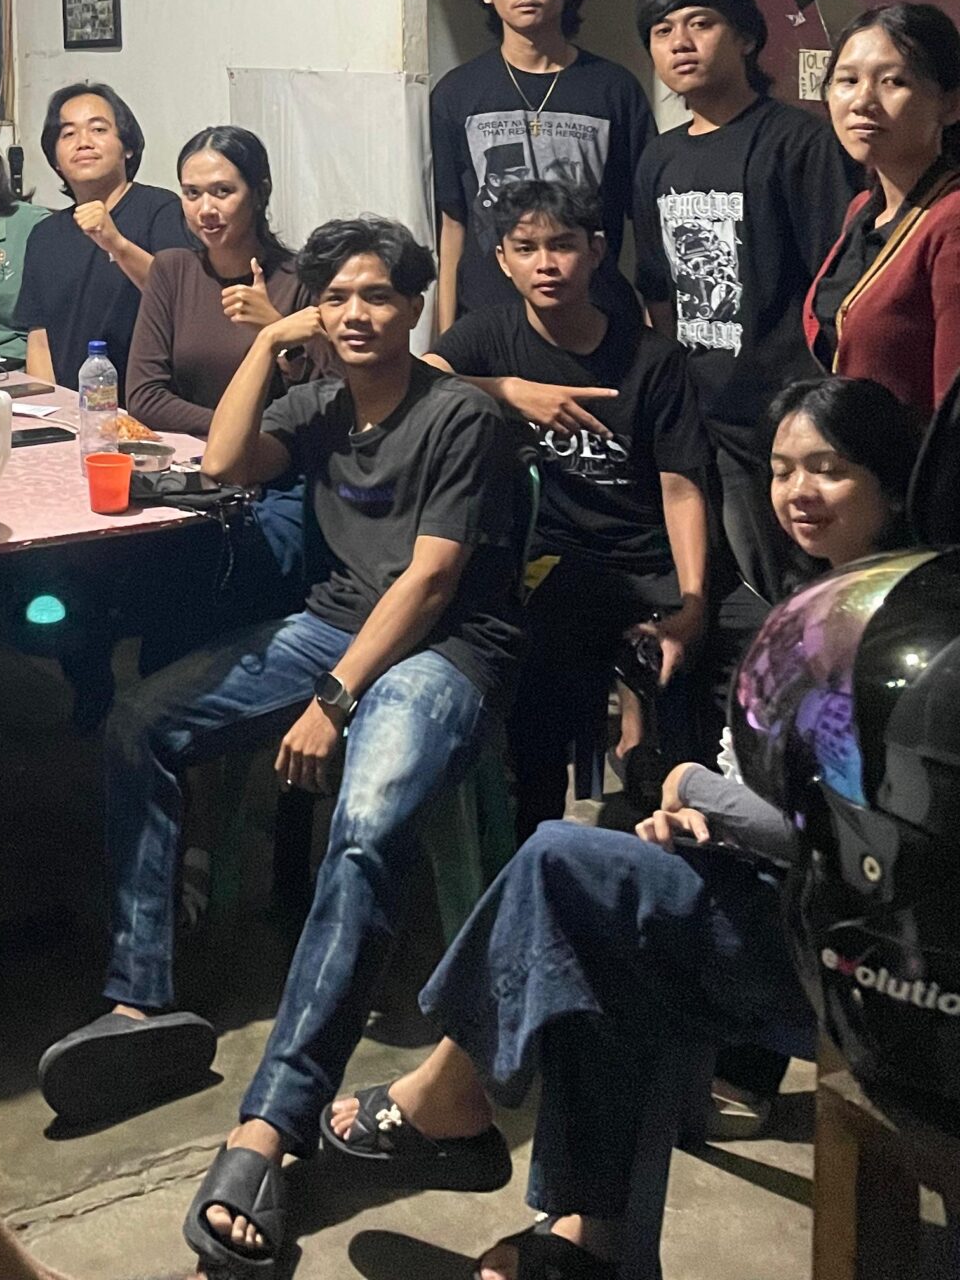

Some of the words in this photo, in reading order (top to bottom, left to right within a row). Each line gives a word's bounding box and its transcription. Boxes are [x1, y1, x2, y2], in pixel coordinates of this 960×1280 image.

[477, 120, 508, 131] GREAT
[555, 121, 563, 129] A
[564, 122, 599, 135] NATION
[482, 128, 505, 137] THAT
[555, 129, 595, 141] HEROES
